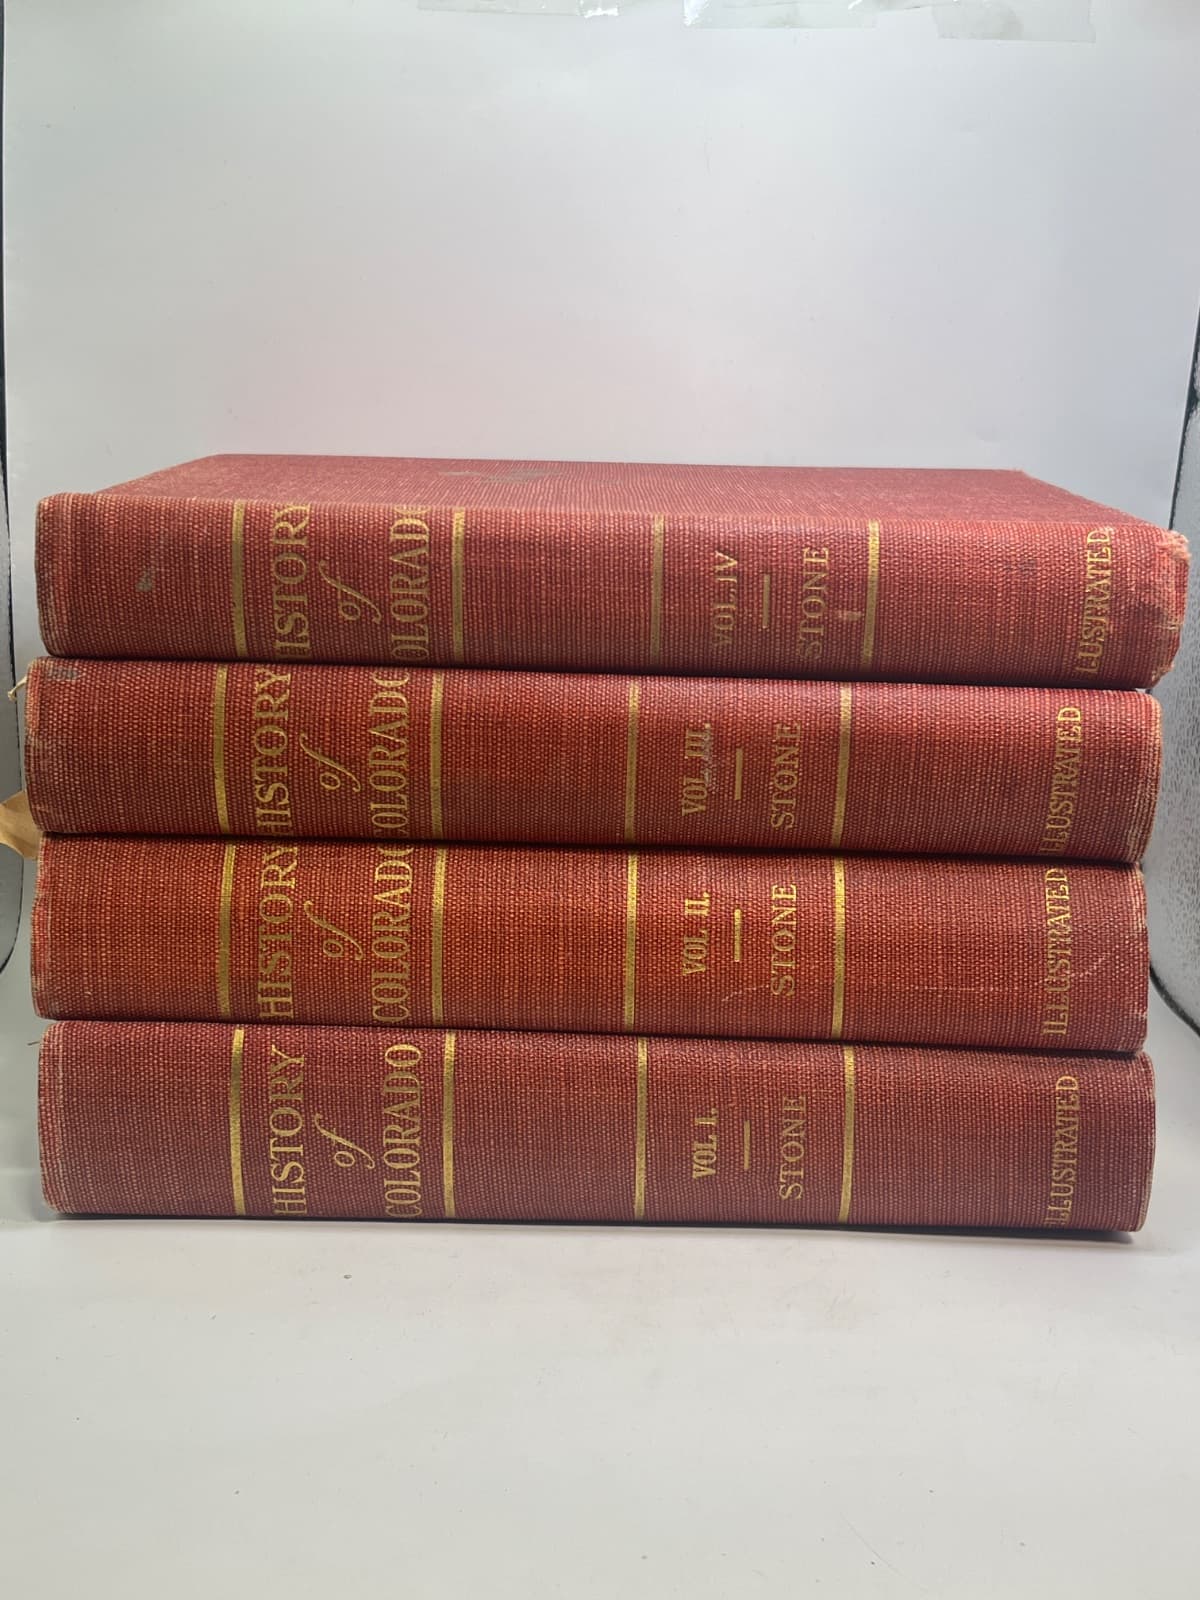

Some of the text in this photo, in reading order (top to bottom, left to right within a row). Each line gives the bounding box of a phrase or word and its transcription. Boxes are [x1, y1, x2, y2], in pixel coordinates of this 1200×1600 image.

[319, 560, 382, 625] of
[799, 547, 829, 660] STONE
[300, 732, 362, 793] of
[770, 723, 801, 830] STONE
[304, 900, 364, 960] of
[770, 884, 797, 996] STONE
[1042, 867, 1072, 1035] ILLUSTRATED
[269, 1044, 307, 1216] HISTORY
[314, 1113, 375, 1169] of
[383, 1043, 423, 1217] COLORADO
[779, 1096, 806, 1200] STONE
